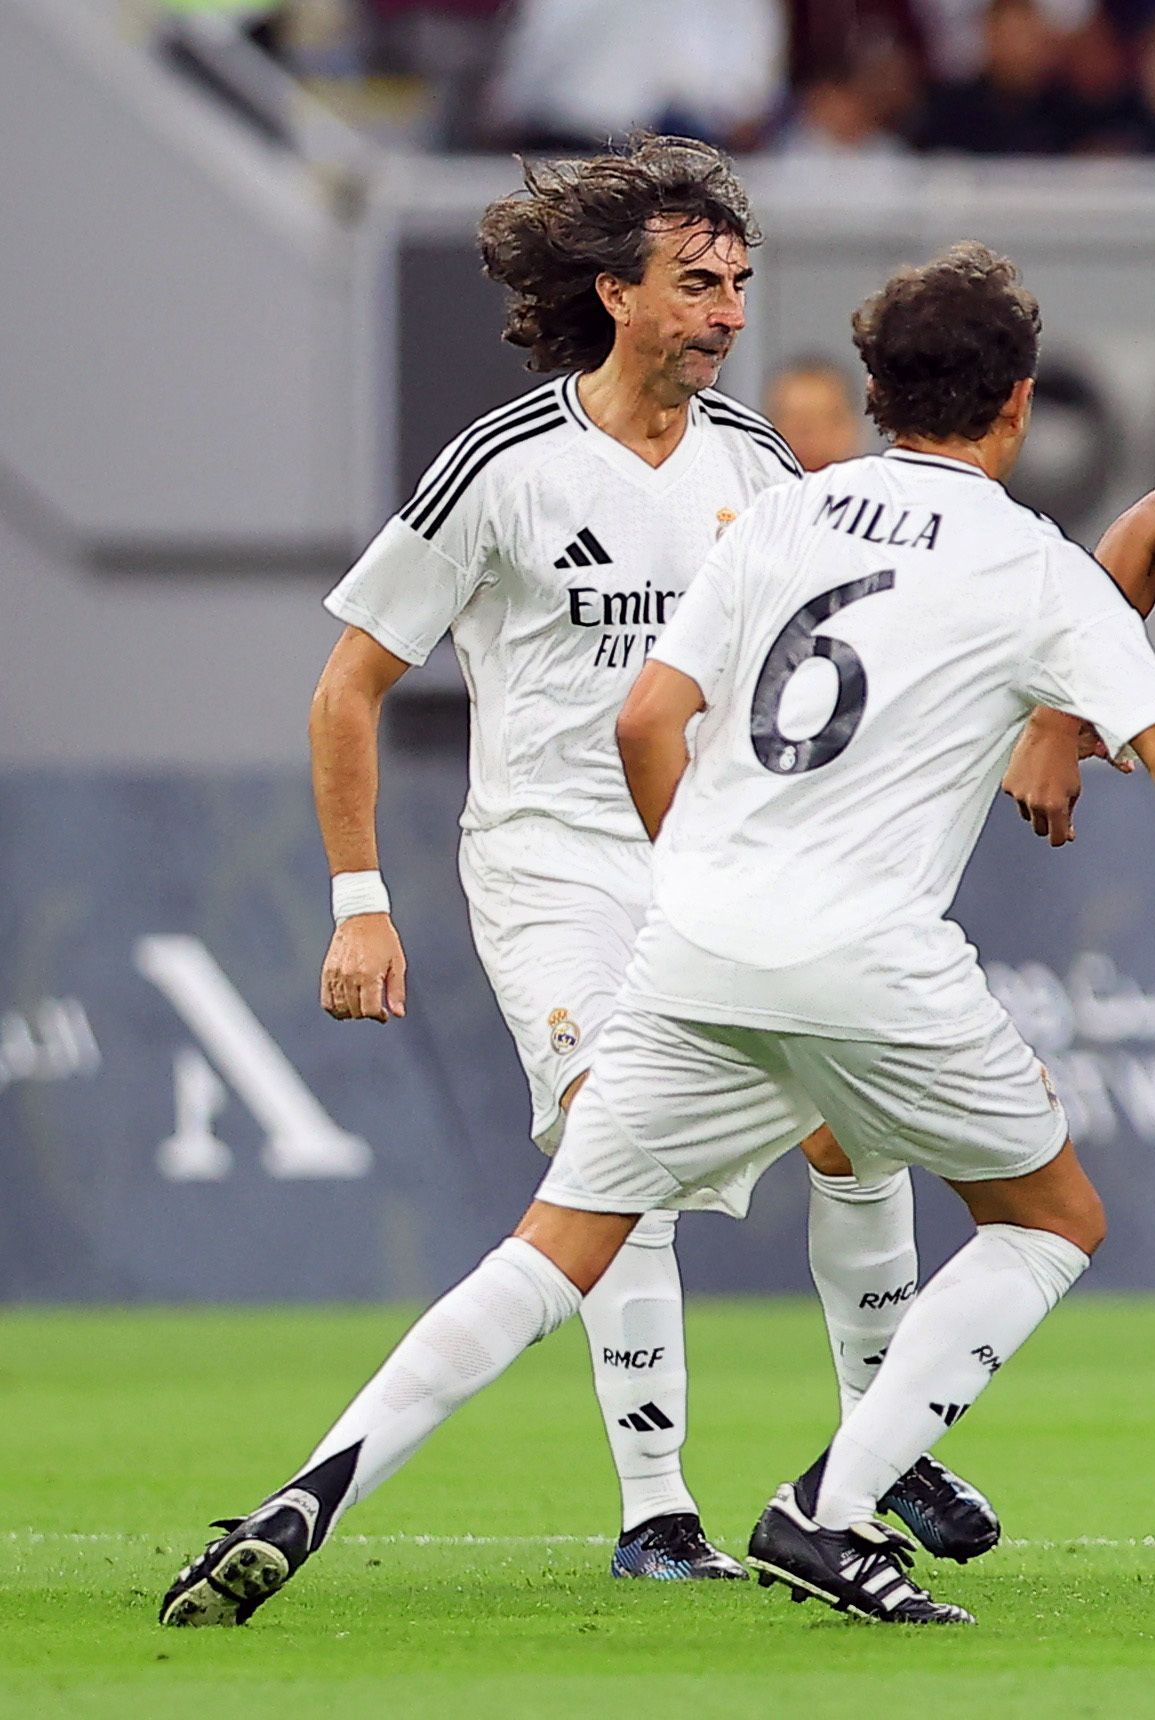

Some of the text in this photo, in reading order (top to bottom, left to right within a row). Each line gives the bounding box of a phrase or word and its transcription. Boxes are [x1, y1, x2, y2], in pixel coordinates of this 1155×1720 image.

[811, 494, 942, 550] MILLA
[567, 579, 686, 627] Emir
[593, 633, 636, 668] FLY
[750, 568, 897, 775] 6
[859, 1280, 917, 1309] RMC
[603, 1346, 665, 1369] RMCF
